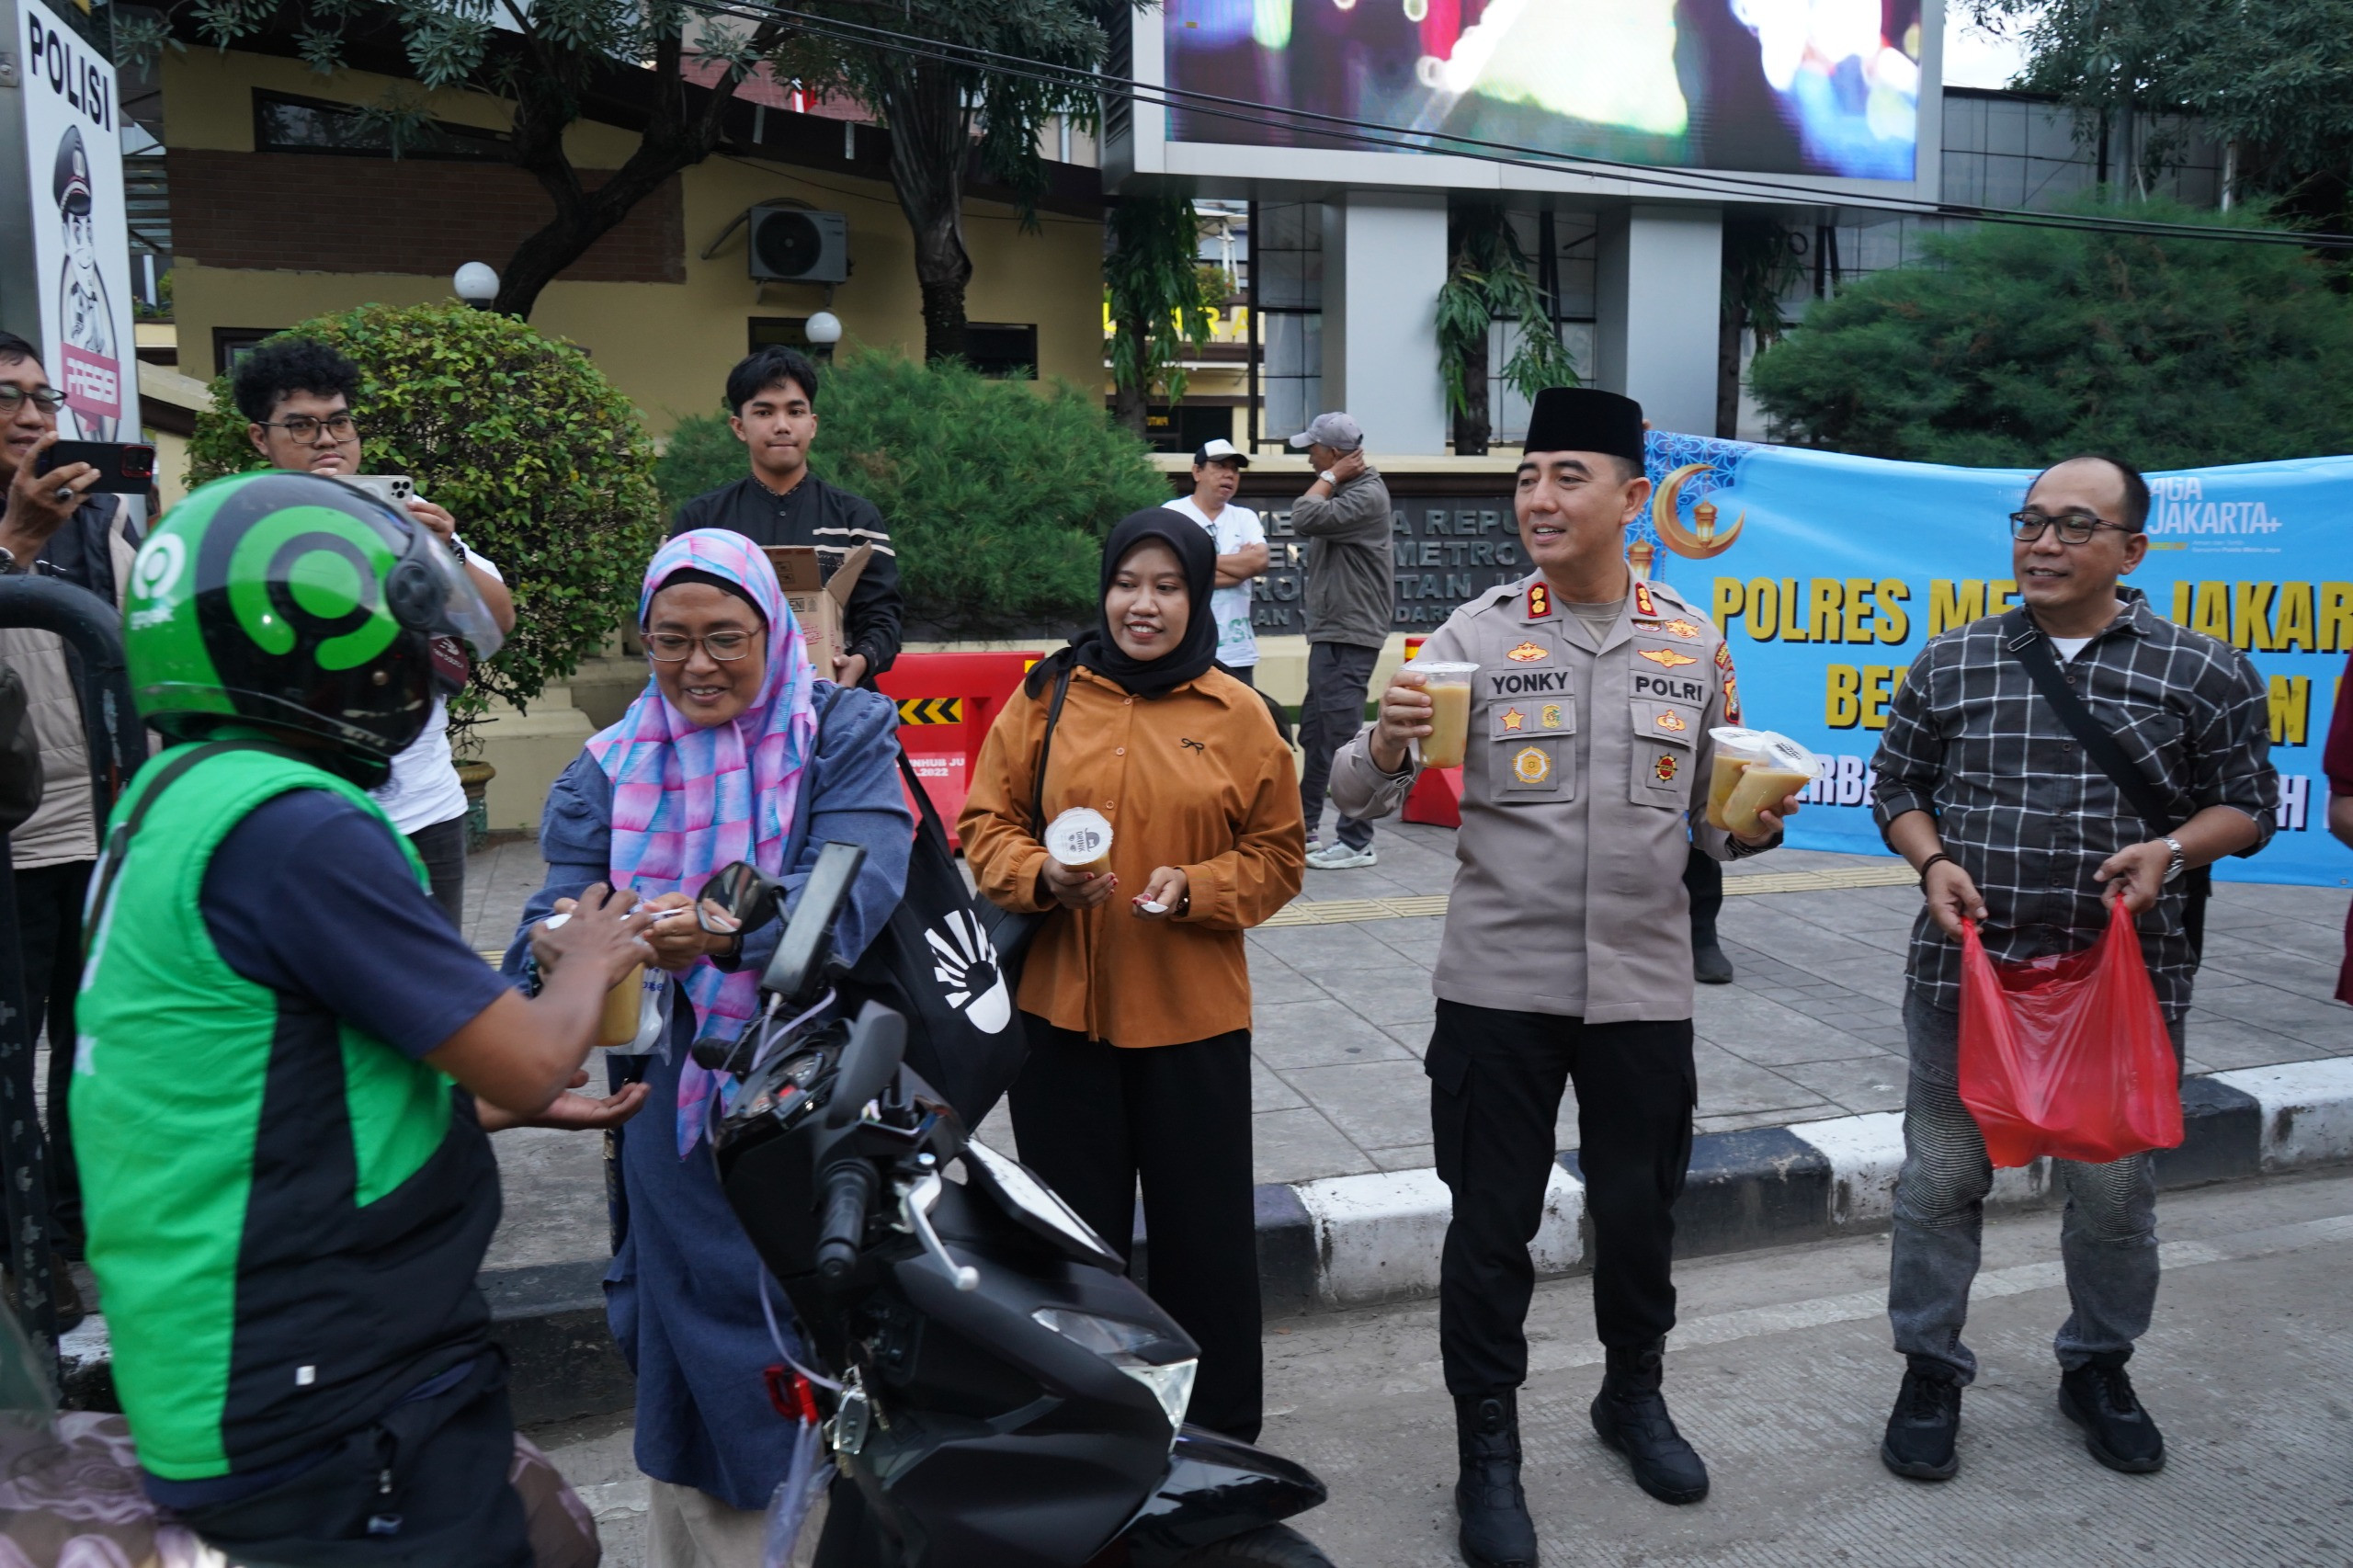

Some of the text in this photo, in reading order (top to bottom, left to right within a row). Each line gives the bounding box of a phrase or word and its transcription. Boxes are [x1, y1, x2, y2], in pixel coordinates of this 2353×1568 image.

[28, 10, 110, 133] POLISI
[1711, 577, 1909, 645] POLRES
[1491, 672, 1569, 695] YONKY
[1635, 676, 1703, 702] POLRI
[1075, 830, 1086, 853] DRINK
